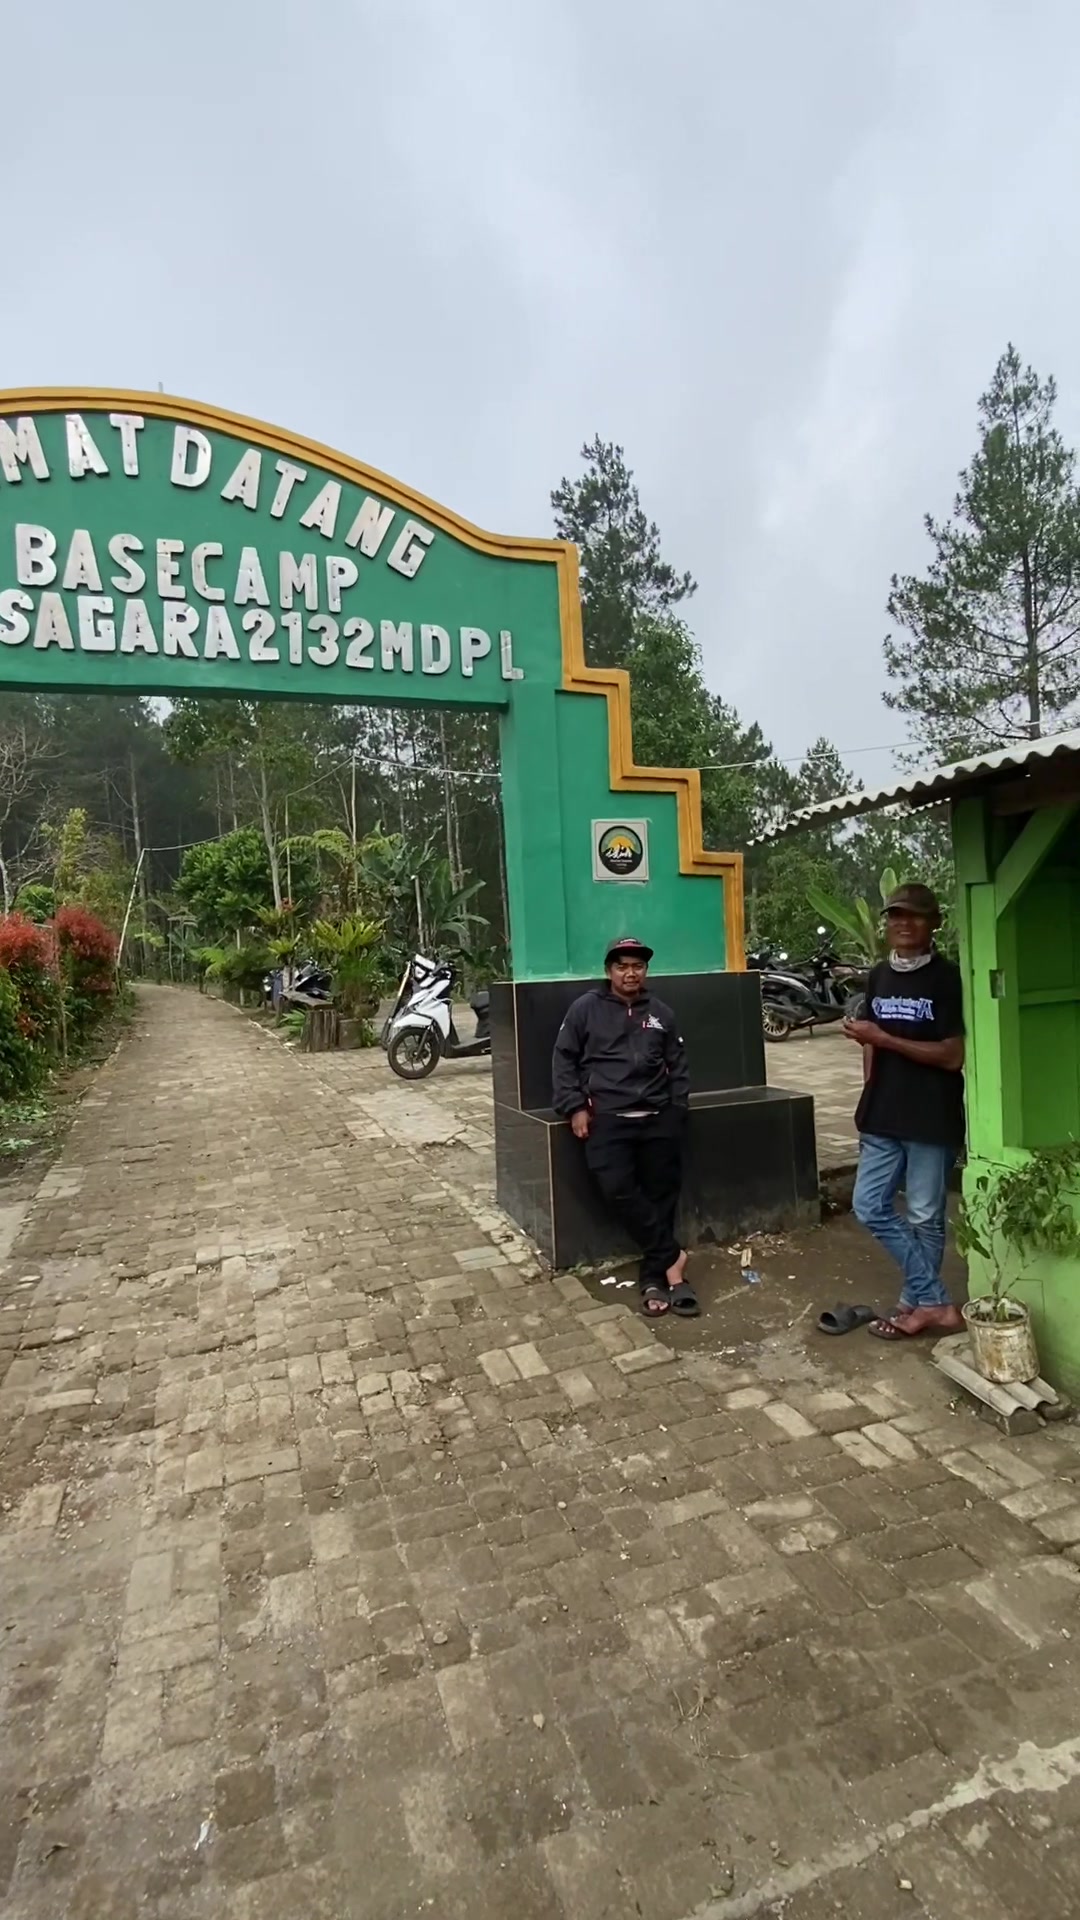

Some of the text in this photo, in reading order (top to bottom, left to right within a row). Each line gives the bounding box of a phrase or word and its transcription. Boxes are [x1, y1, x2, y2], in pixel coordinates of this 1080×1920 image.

[0, 413, 436, 578] MAT DATANG
[15, 523, 359, 612] BASECAMP
